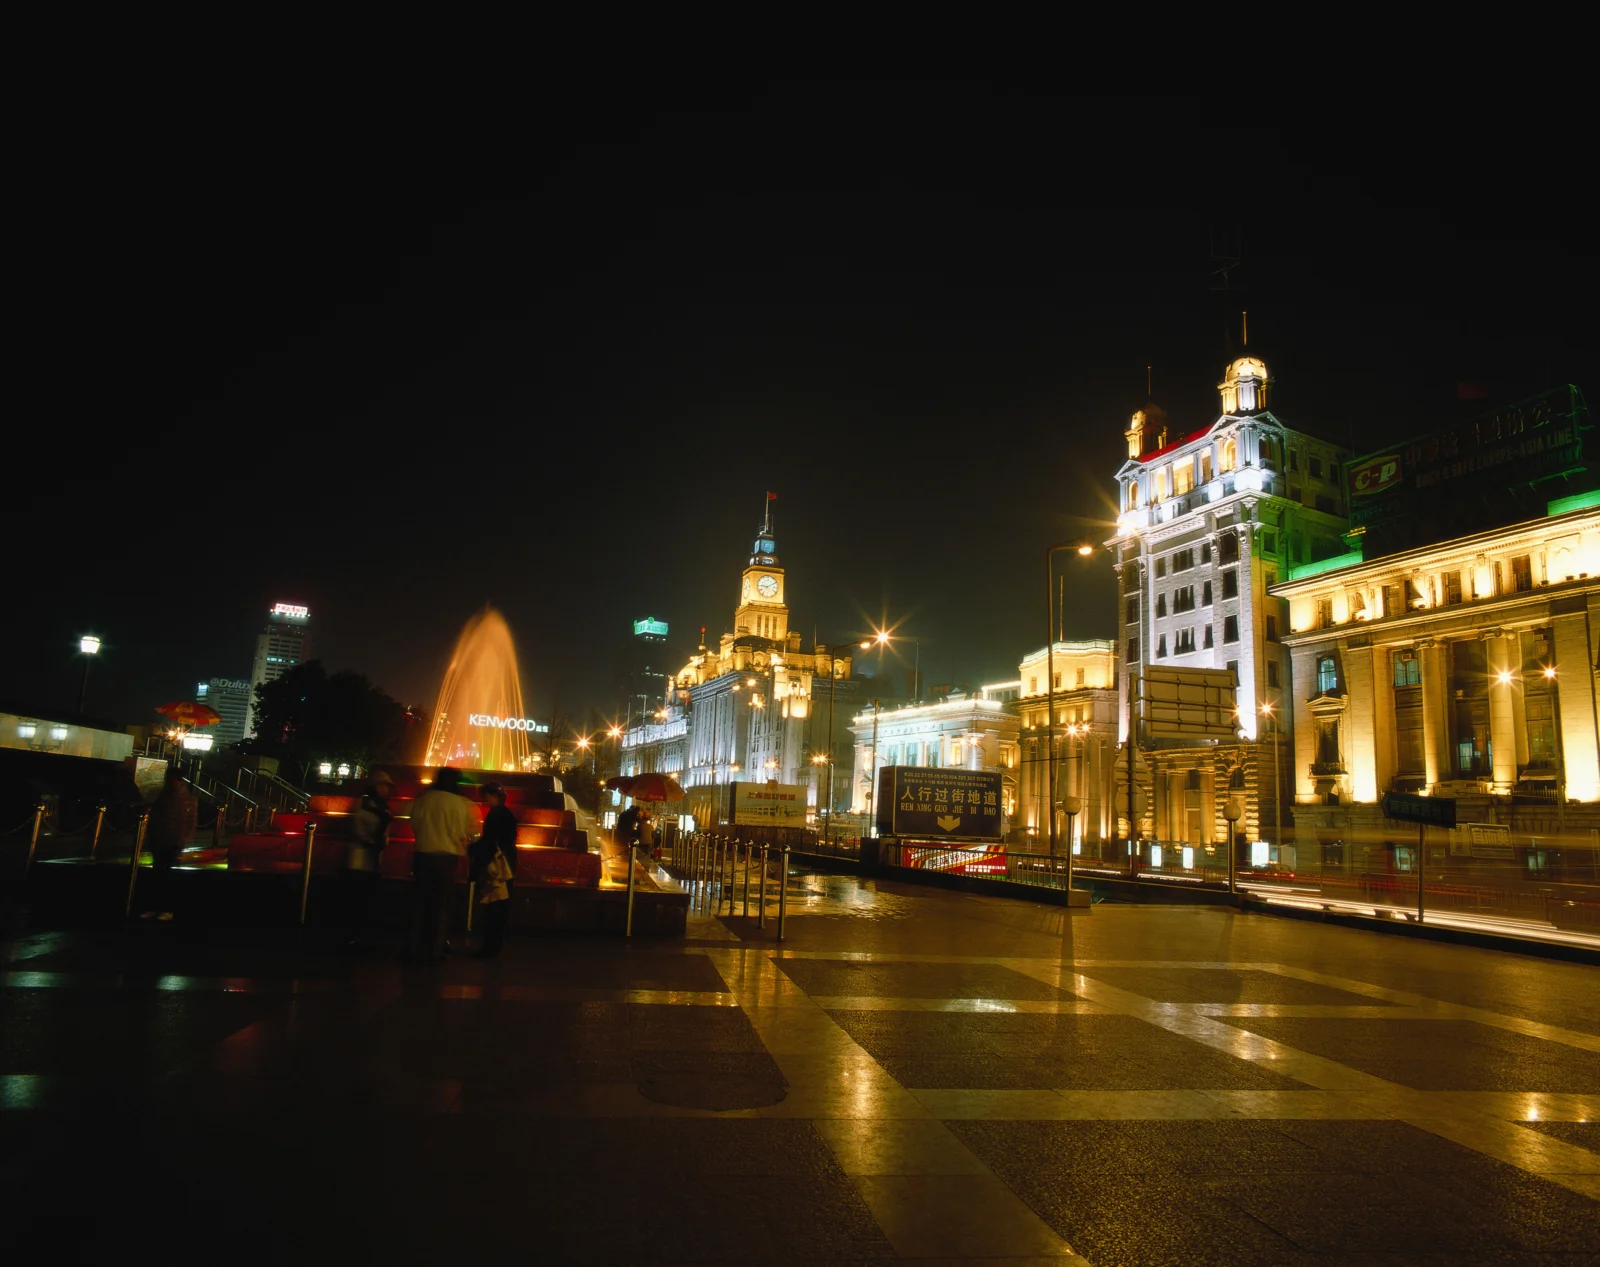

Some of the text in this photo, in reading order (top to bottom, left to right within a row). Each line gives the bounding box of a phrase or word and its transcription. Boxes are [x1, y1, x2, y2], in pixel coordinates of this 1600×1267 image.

[469, 714, 536, 731] KENWOOD
[901, 786, 997, 806] 人行过街地道
[901, 803, 914, 811] REN
[917, 803, 932, 812] XING
[935, 805, 948, 813] GUO
[953, 806, 964, 814] JIE
[984, 807, 997, 815] DAO
